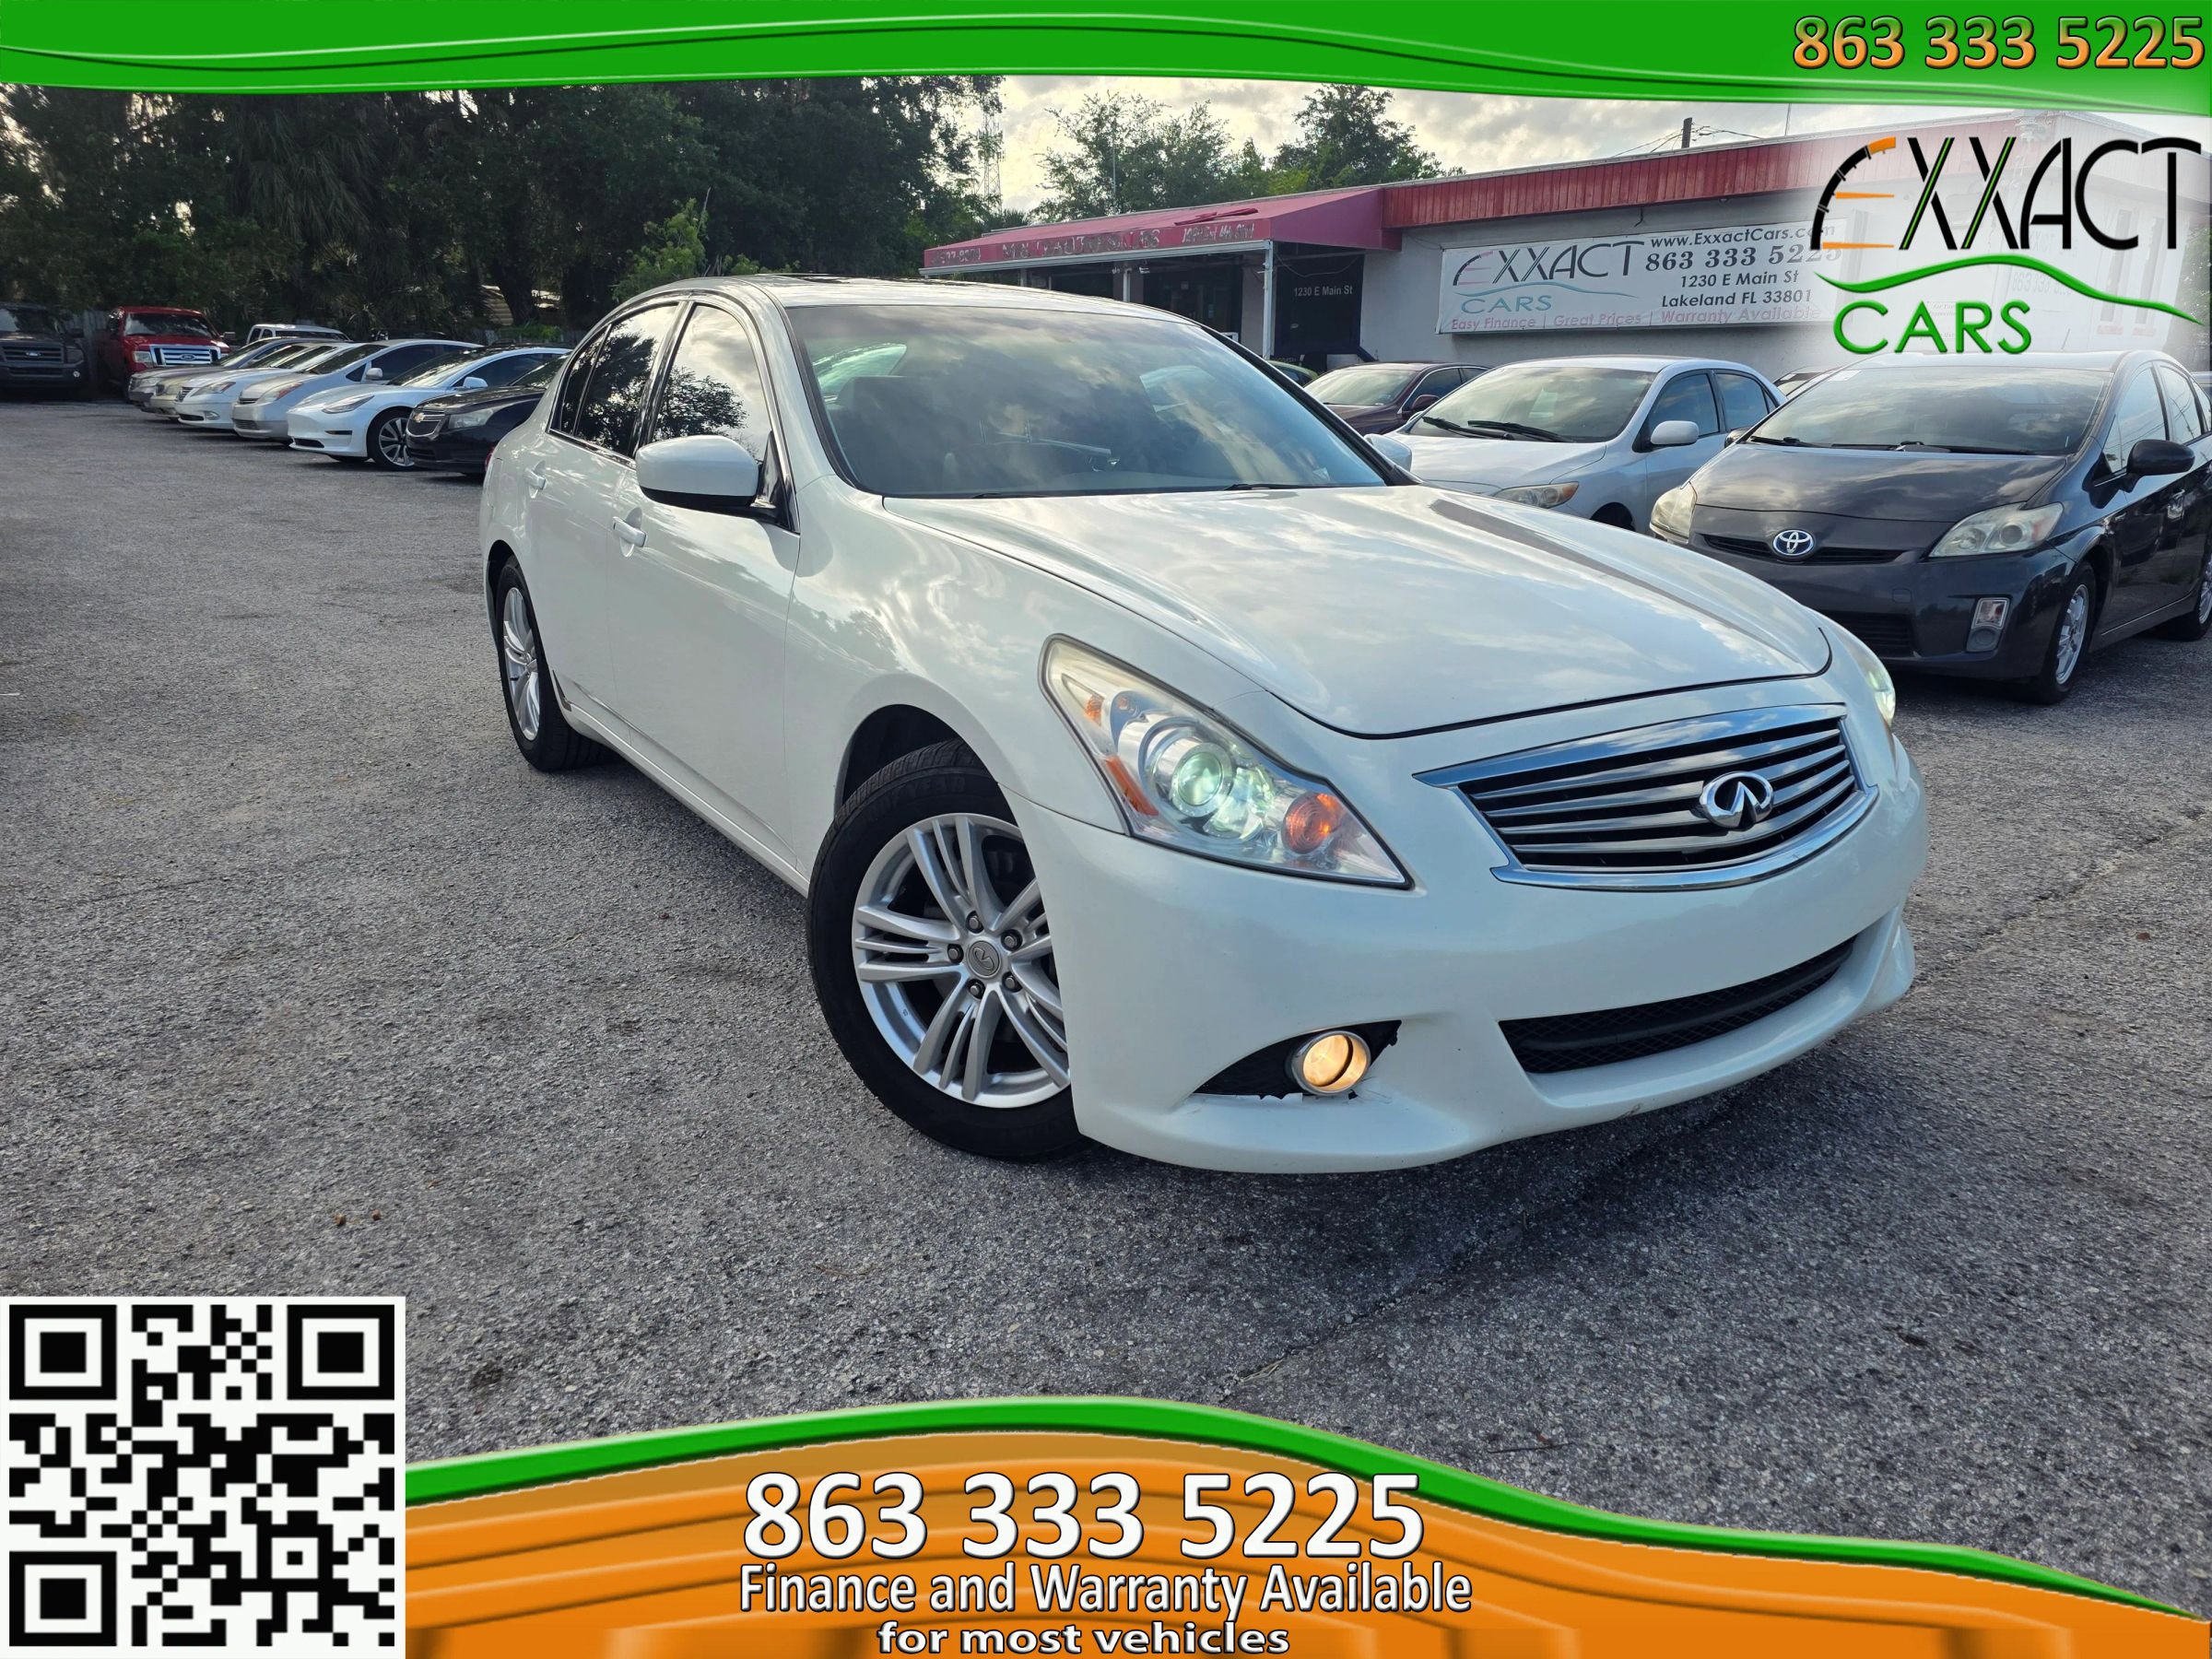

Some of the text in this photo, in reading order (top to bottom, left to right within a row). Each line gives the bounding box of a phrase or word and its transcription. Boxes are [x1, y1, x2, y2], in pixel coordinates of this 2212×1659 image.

[1651, 225, 1835, 248] www.ExxactCars.cm
[1453, 241, 1645, 286] EXXACT
[1645, 251, 1694, 272] 863
[1705, 246, 1757, 268] 333
[1680, 269, 1799, 288] 1230 E Main St
[1294, 285, 1353, 297] 1230 E Main St
[1662, 288, 1811, 307] Lakeland FL 33801
[1461, 295, 1552, 314] CARS
[1452, 307, 1821, 332] Easy Finance Great Prices Warranty Available
